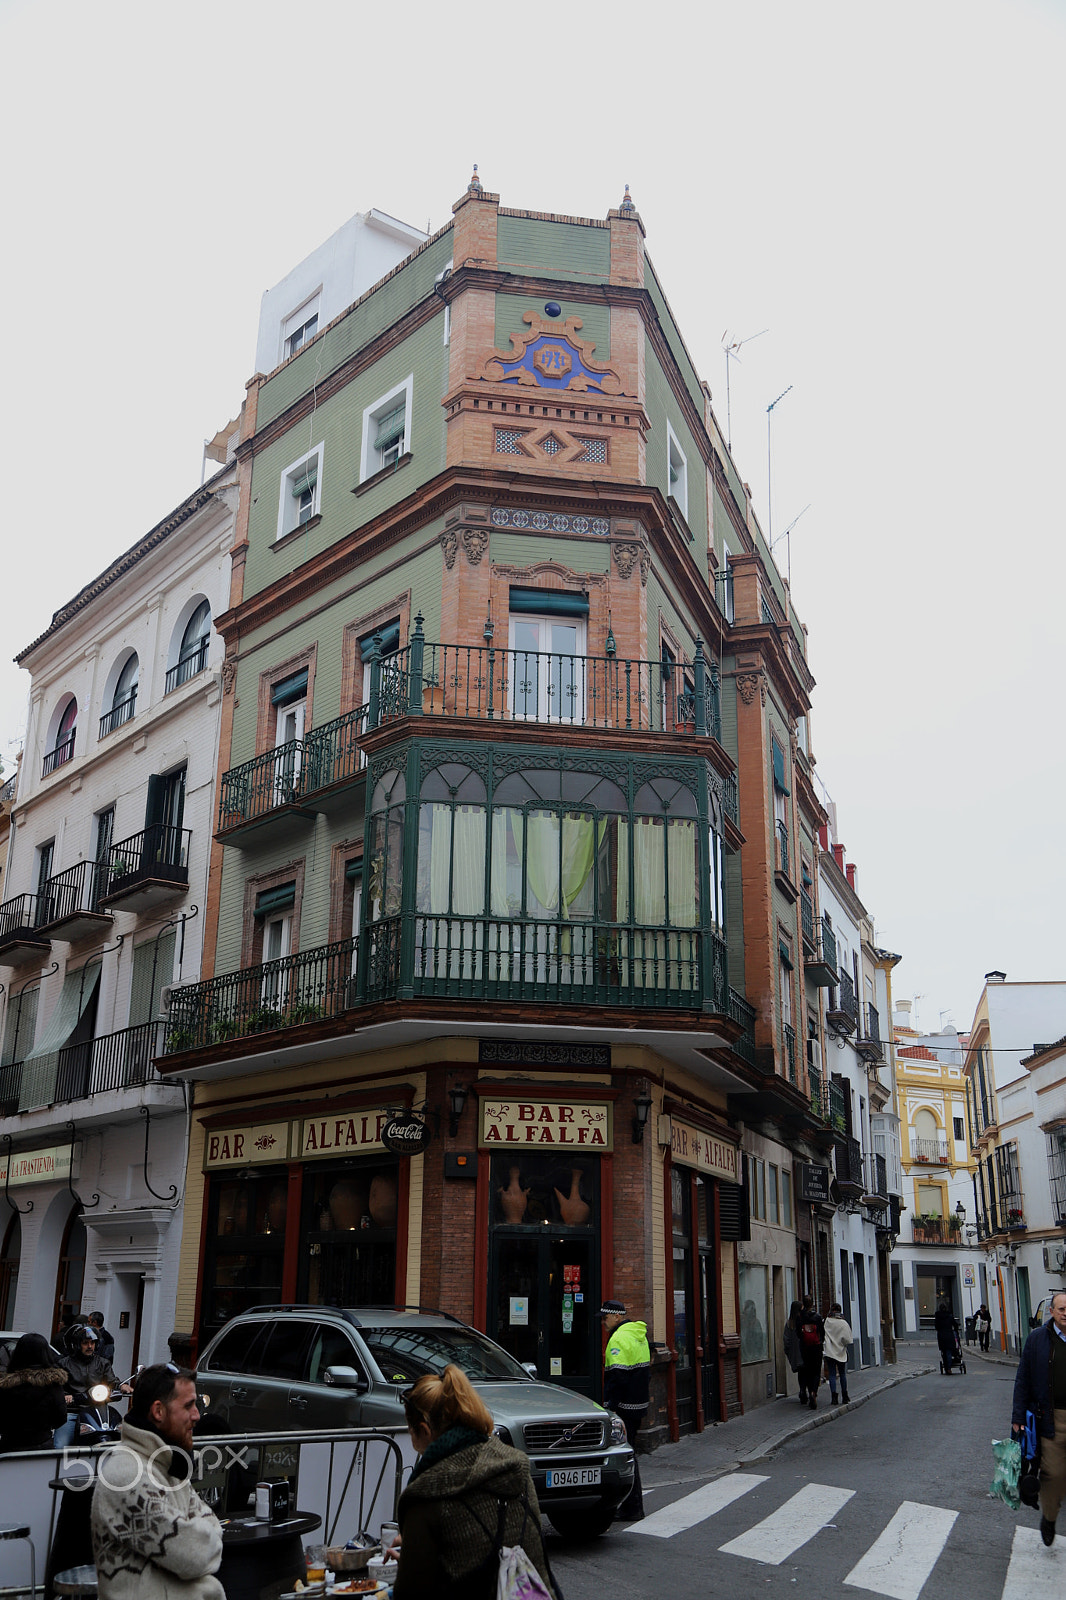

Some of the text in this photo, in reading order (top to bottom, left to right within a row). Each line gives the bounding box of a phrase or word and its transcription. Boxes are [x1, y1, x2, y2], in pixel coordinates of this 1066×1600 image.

[518, 1104, 575, 1123] BAR
[208, 1113, 396, 1160] BAR ALFALF
[485, 1124, 605, 1144] ALFALFA
[671, 1125, 735, 1173] BAR ALFALFA
[19, 1155, 55, 1176] TRASTIENDA
[553, 1469, 599, 1486] 0946 FDF
